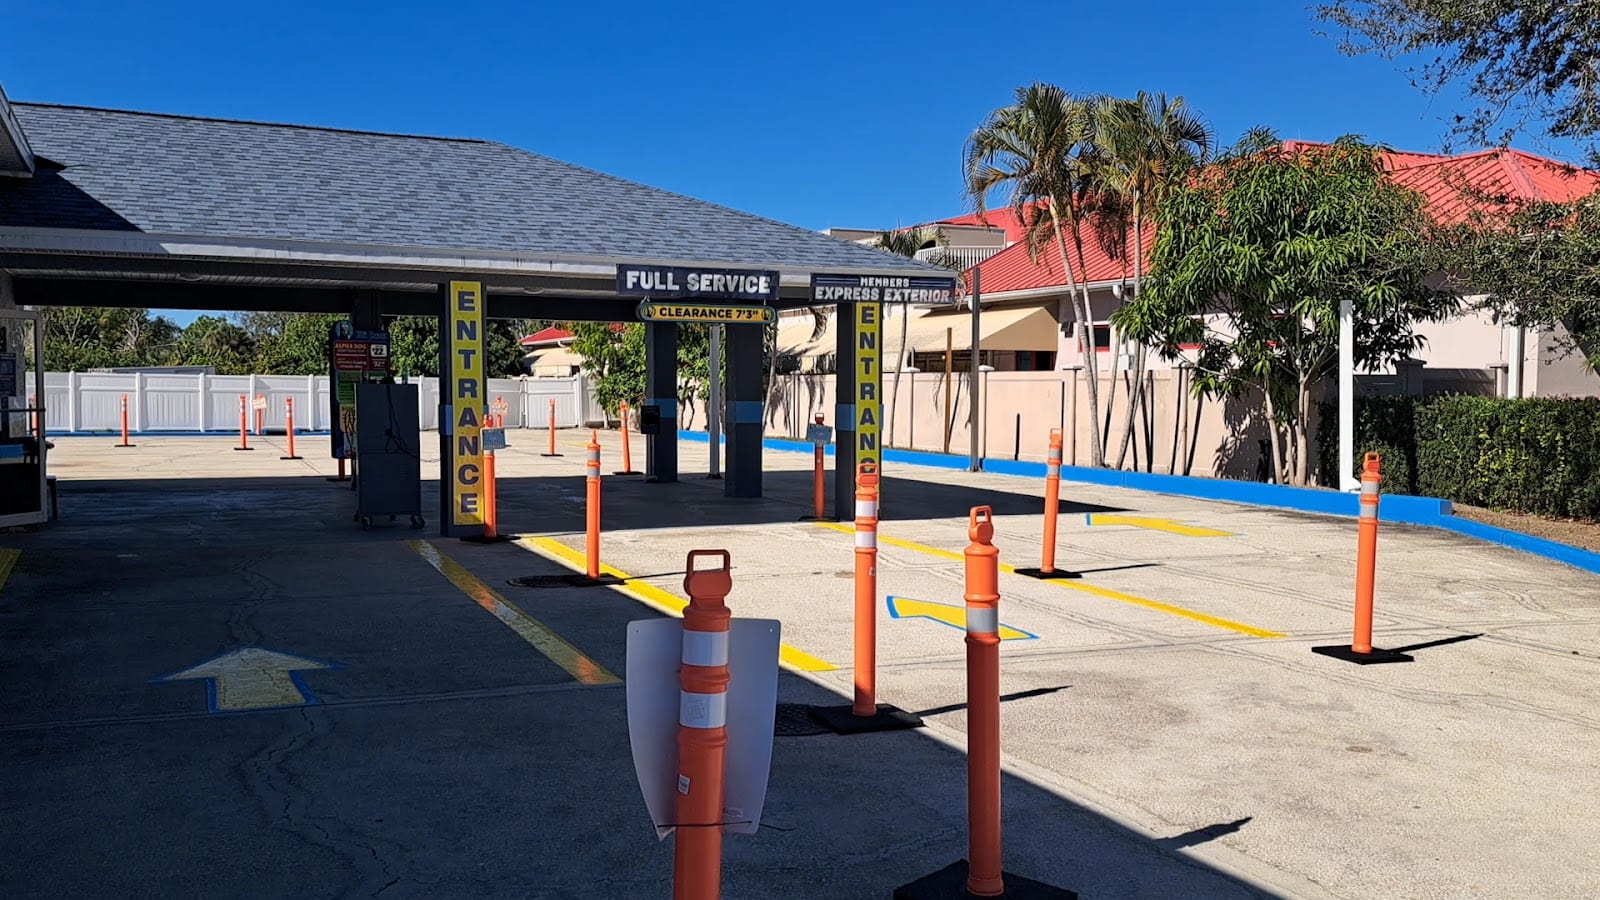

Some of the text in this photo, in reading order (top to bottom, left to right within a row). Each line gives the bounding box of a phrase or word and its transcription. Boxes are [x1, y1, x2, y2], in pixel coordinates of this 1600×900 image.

[626, 270, 771, 294] FULL SERVICE
[860, 276, 910, 288] MEMBERS
[815, 286, 950, 303] EXPRESS EXTERIOR
[659, 307, 759, 319] CLEARANCE 7'3"
[860, 305, 876, 474] ENTRANC
[456, 290, 480, 514] ENTRANCE
